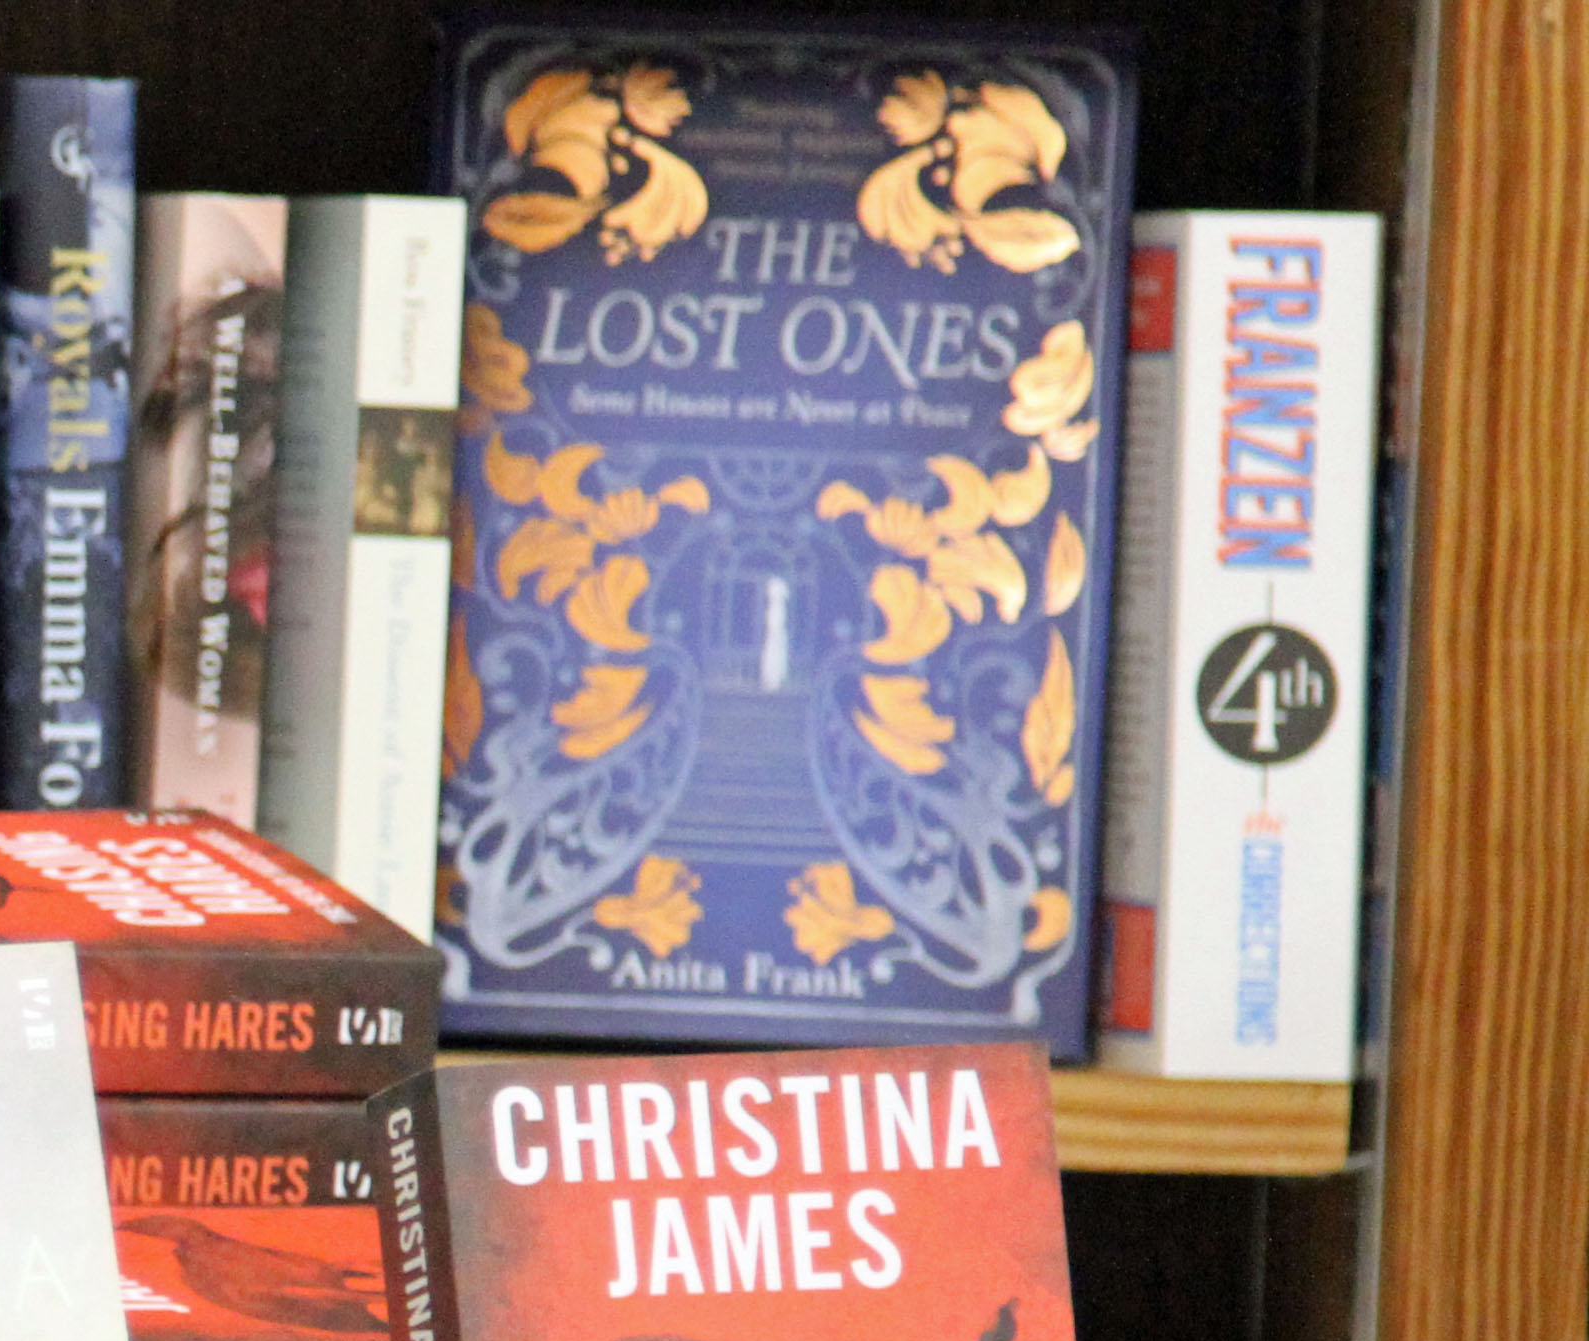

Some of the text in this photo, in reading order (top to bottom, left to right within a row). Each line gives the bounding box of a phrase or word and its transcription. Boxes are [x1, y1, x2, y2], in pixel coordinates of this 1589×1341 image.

[703, 215, 860, 287] THE
[536, 289, 1021, 390] LOST ONES
[1216, 234, 1323, 573] FRANZEN
[40, 246, 110, 705] Royals Emma
[609, 947, 868, 998] Anita Frank
[183, 1001, 317, 1053] HARES
[490, 1068, 1002, 1188] CHRISTINA
[176, 1154, 312, 1206] HARES
[607, 1187, 904, 1300] JAMES
